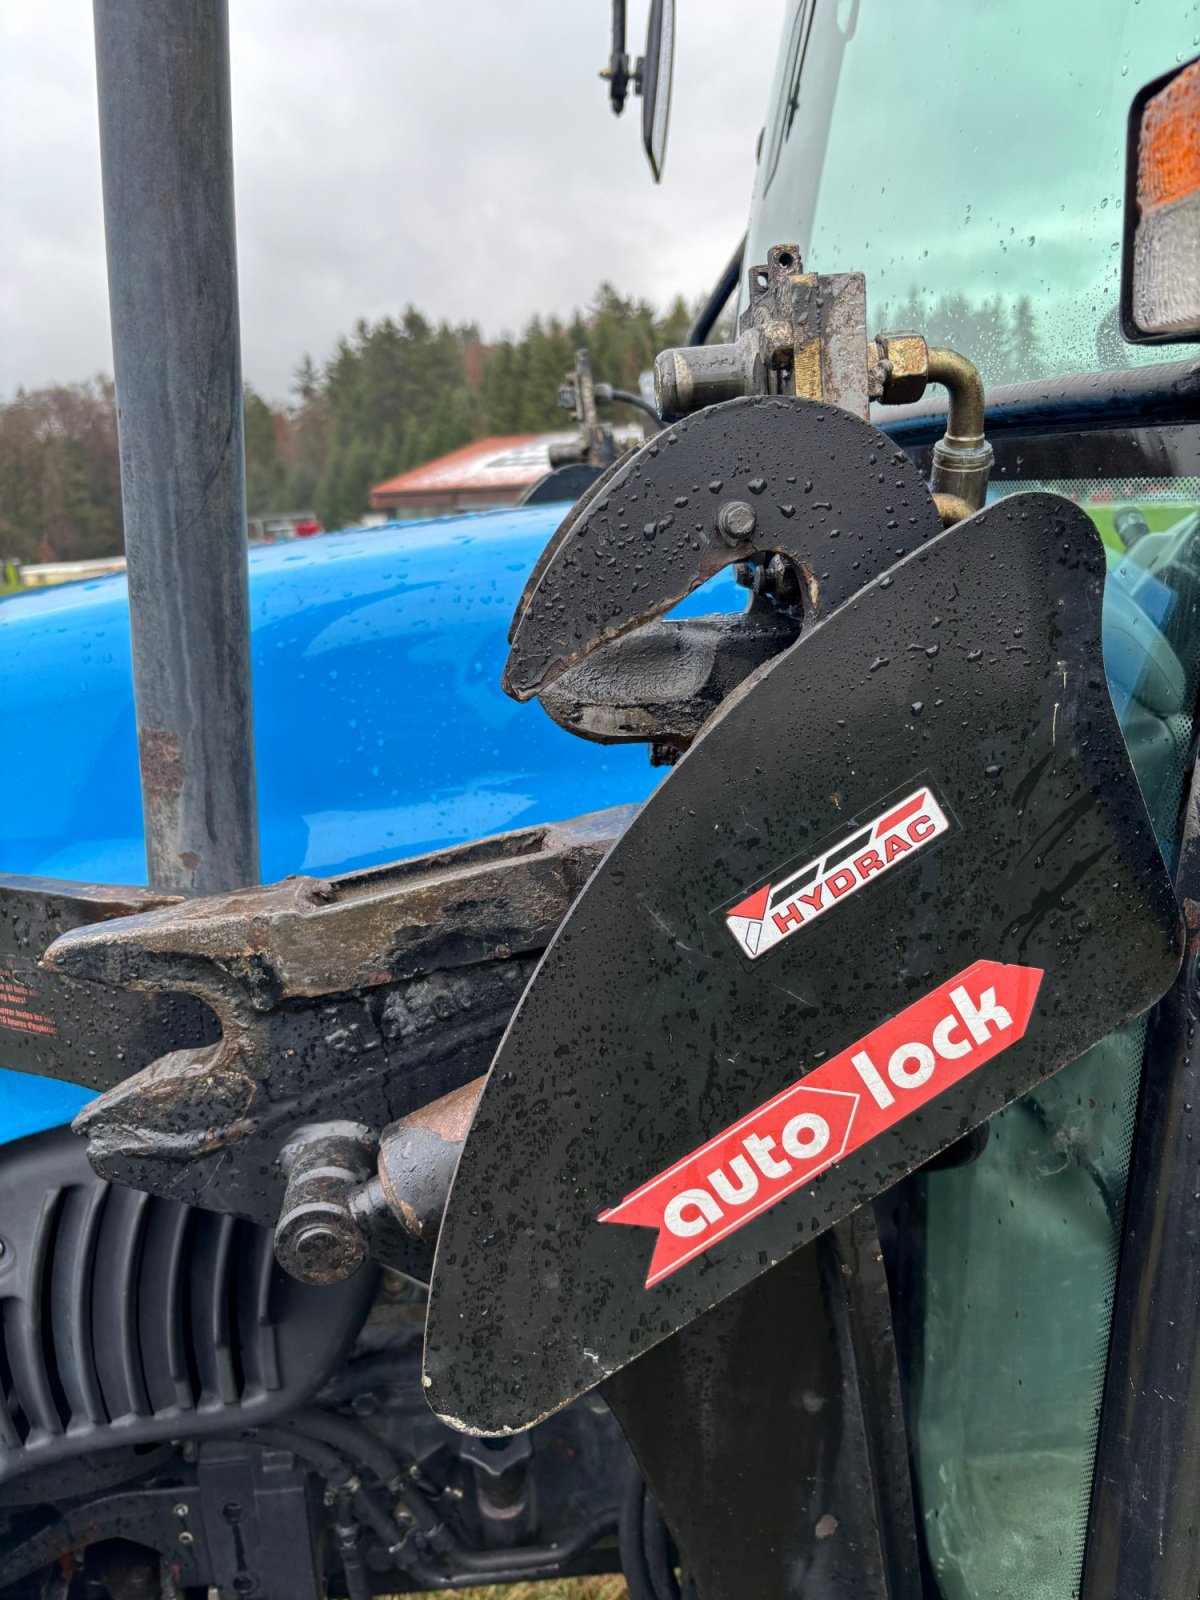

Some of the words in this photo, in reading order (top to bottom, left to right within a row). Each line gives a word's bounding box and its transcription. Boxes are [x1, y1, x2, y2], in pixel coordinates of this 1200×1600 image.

[772, 814, 936, 935] HYDRAC
[663, 1112, 830, 1238] auto
[851, 985, 1014, 1110] lock
